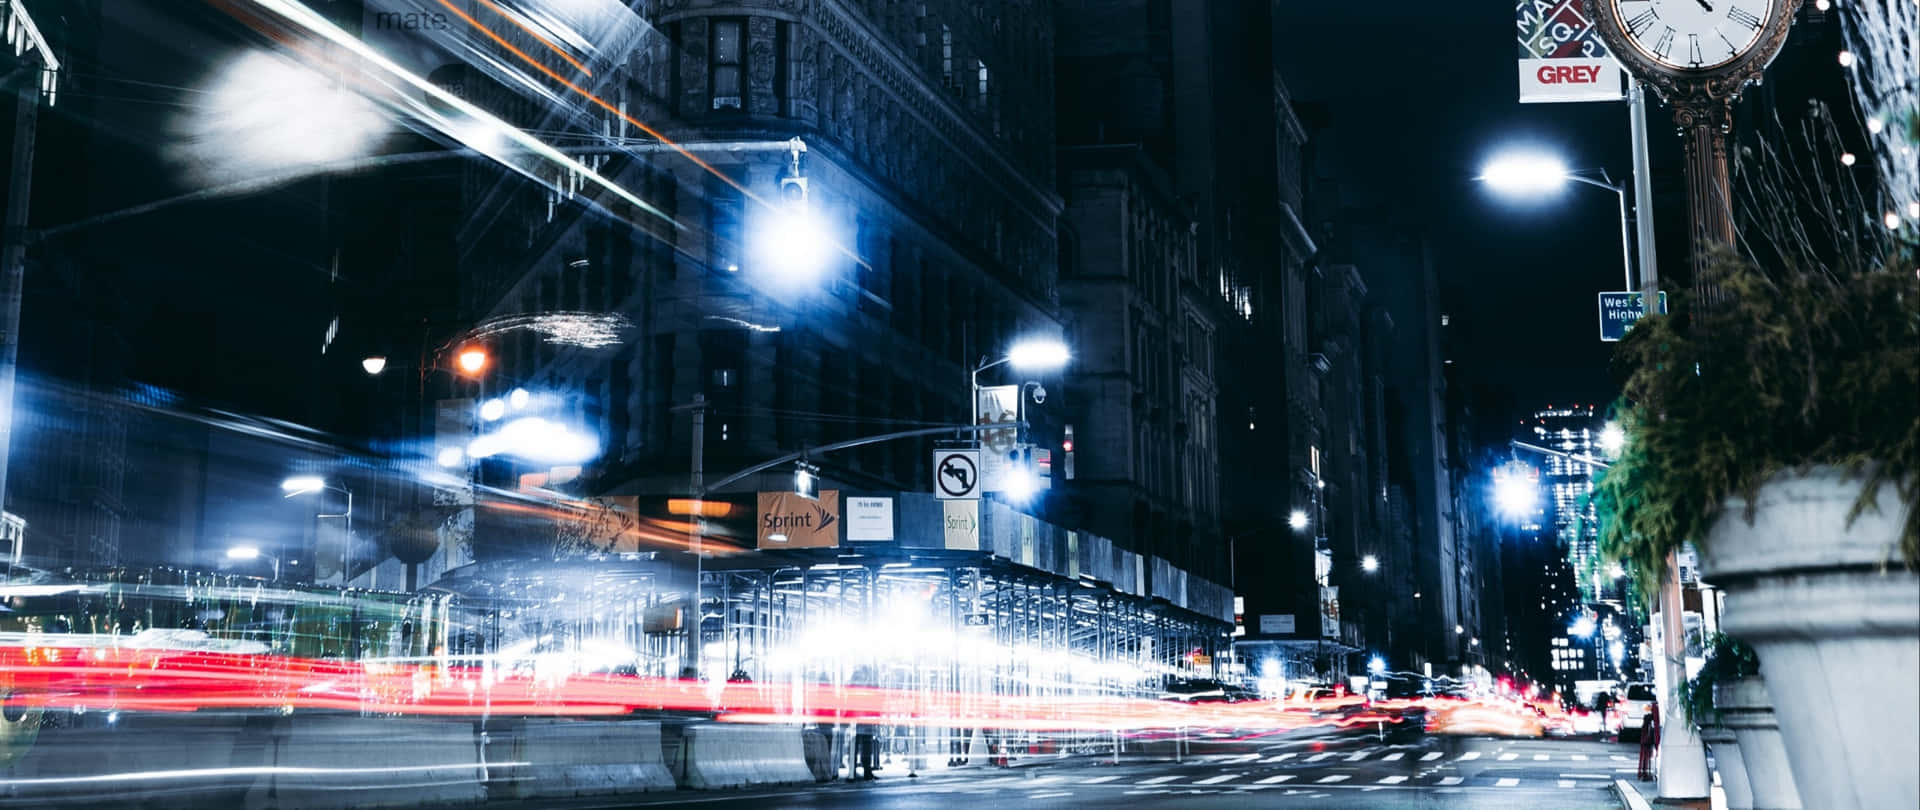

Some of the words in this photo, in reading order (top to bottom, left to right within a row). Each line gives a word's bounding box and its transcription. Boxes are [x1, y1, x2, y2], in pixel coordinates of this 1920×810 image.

[376, 8, 447, 30] mate
[1537, 65, 1601, 84] GREY
[1608, 309, 1644, 322] Highw
[763, 511, 812, 532] Sprint
[947, 515, 969, 530] Sprint
